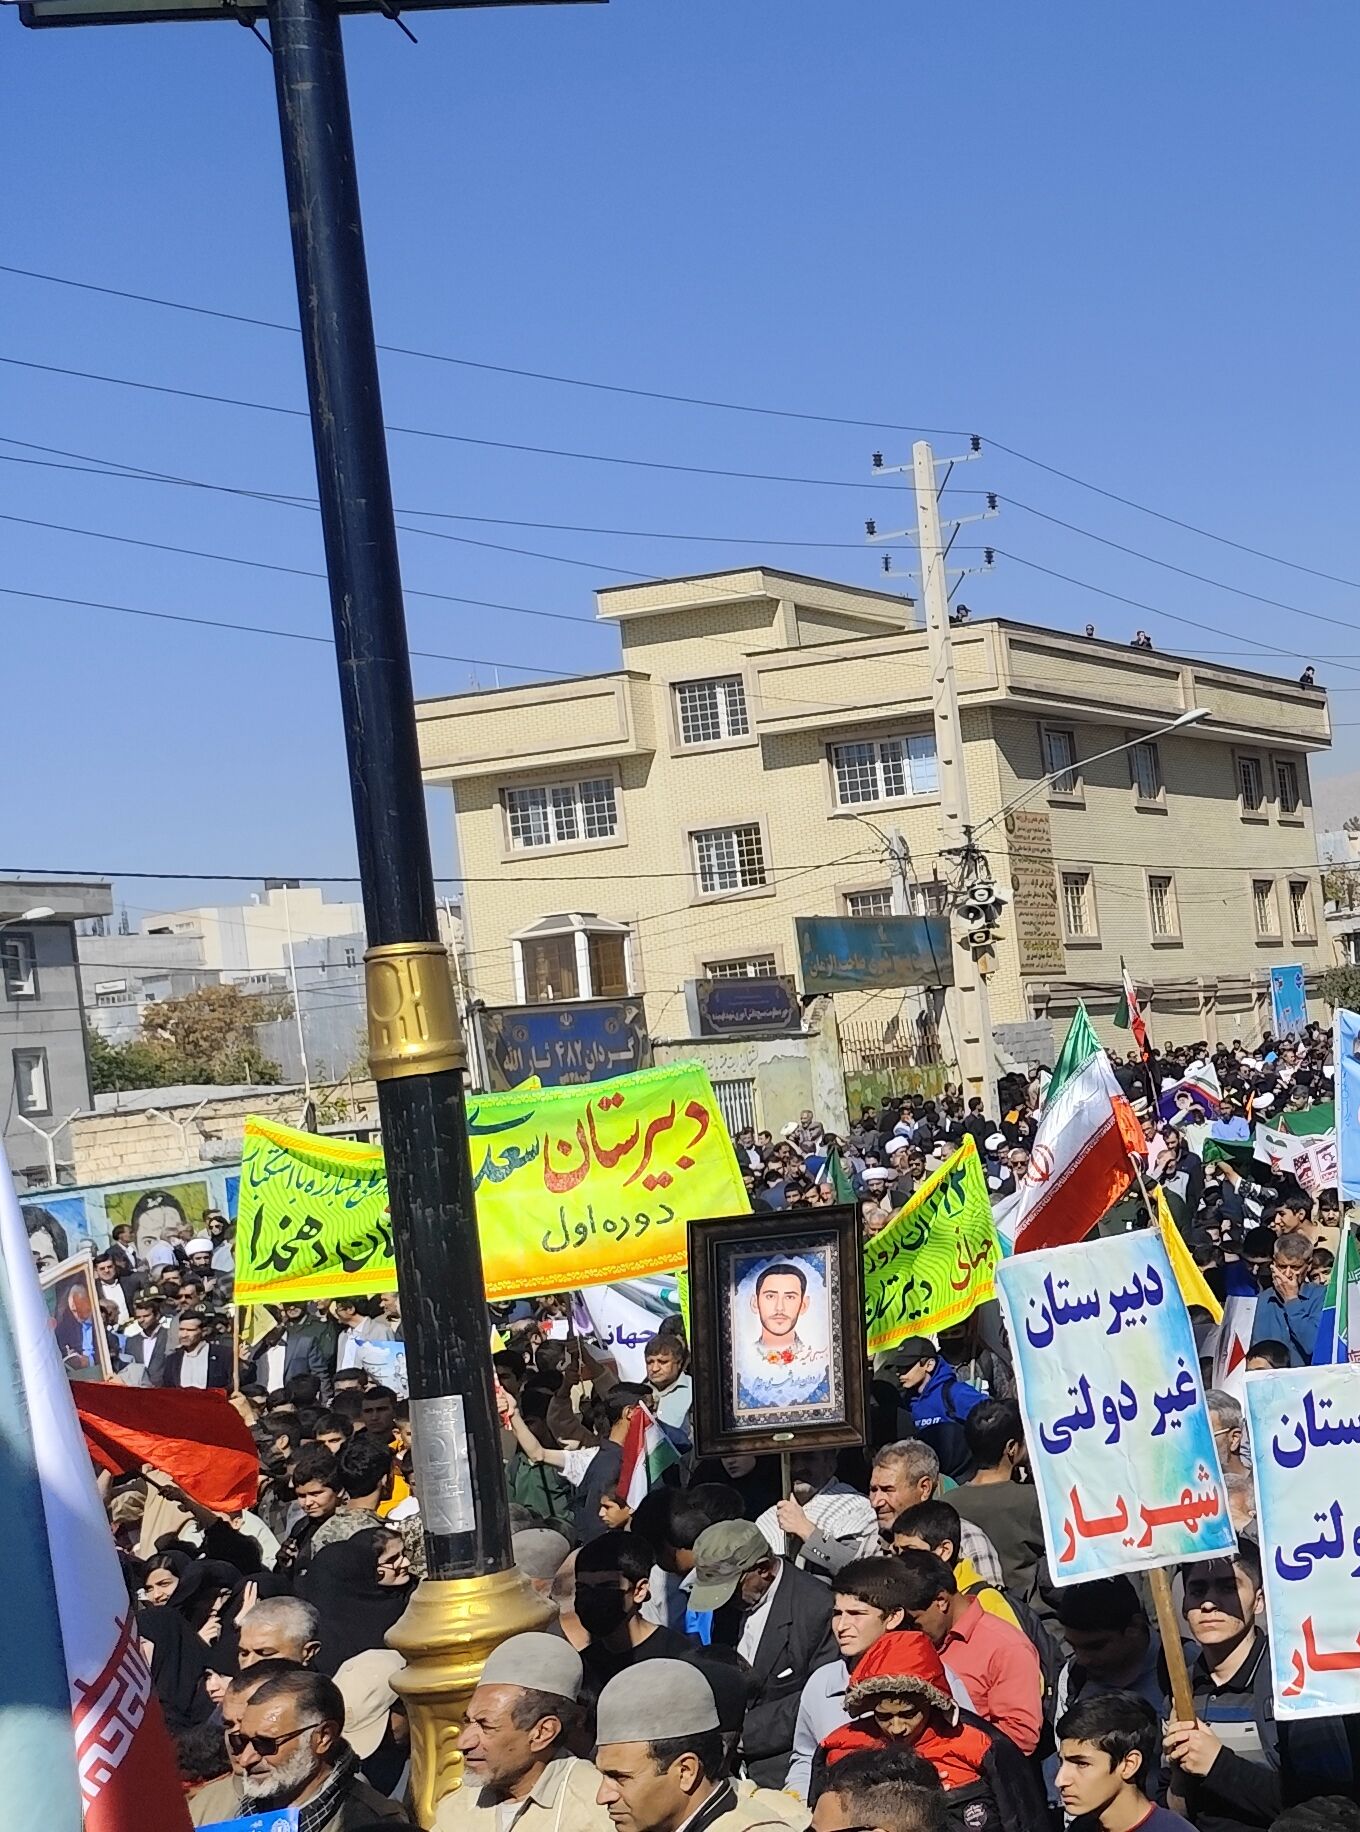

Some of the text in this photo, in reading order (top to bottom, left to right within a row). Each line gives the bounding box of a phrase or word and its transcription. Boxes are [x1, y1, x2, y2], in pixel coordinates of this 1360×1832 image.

[503, 1041, 525, 1071] الله
[528, 1040, 551, 1075] ثار
[585, 1040, 635, 1071] گردان
[543, 1092, 710, 1193] دبیرستان
[251, 1203, 329, 1272] دهخدا
[541, 1203, 676, 1253] دوره اول
[950, 1226, 993, 1291] جهانی
[1026, 1263, 1164, 1349] دبیرستان
[1039, 1355, 1197, 1455] غیر دولتی
[1059, 1464, 1219, 1563] شهریار
